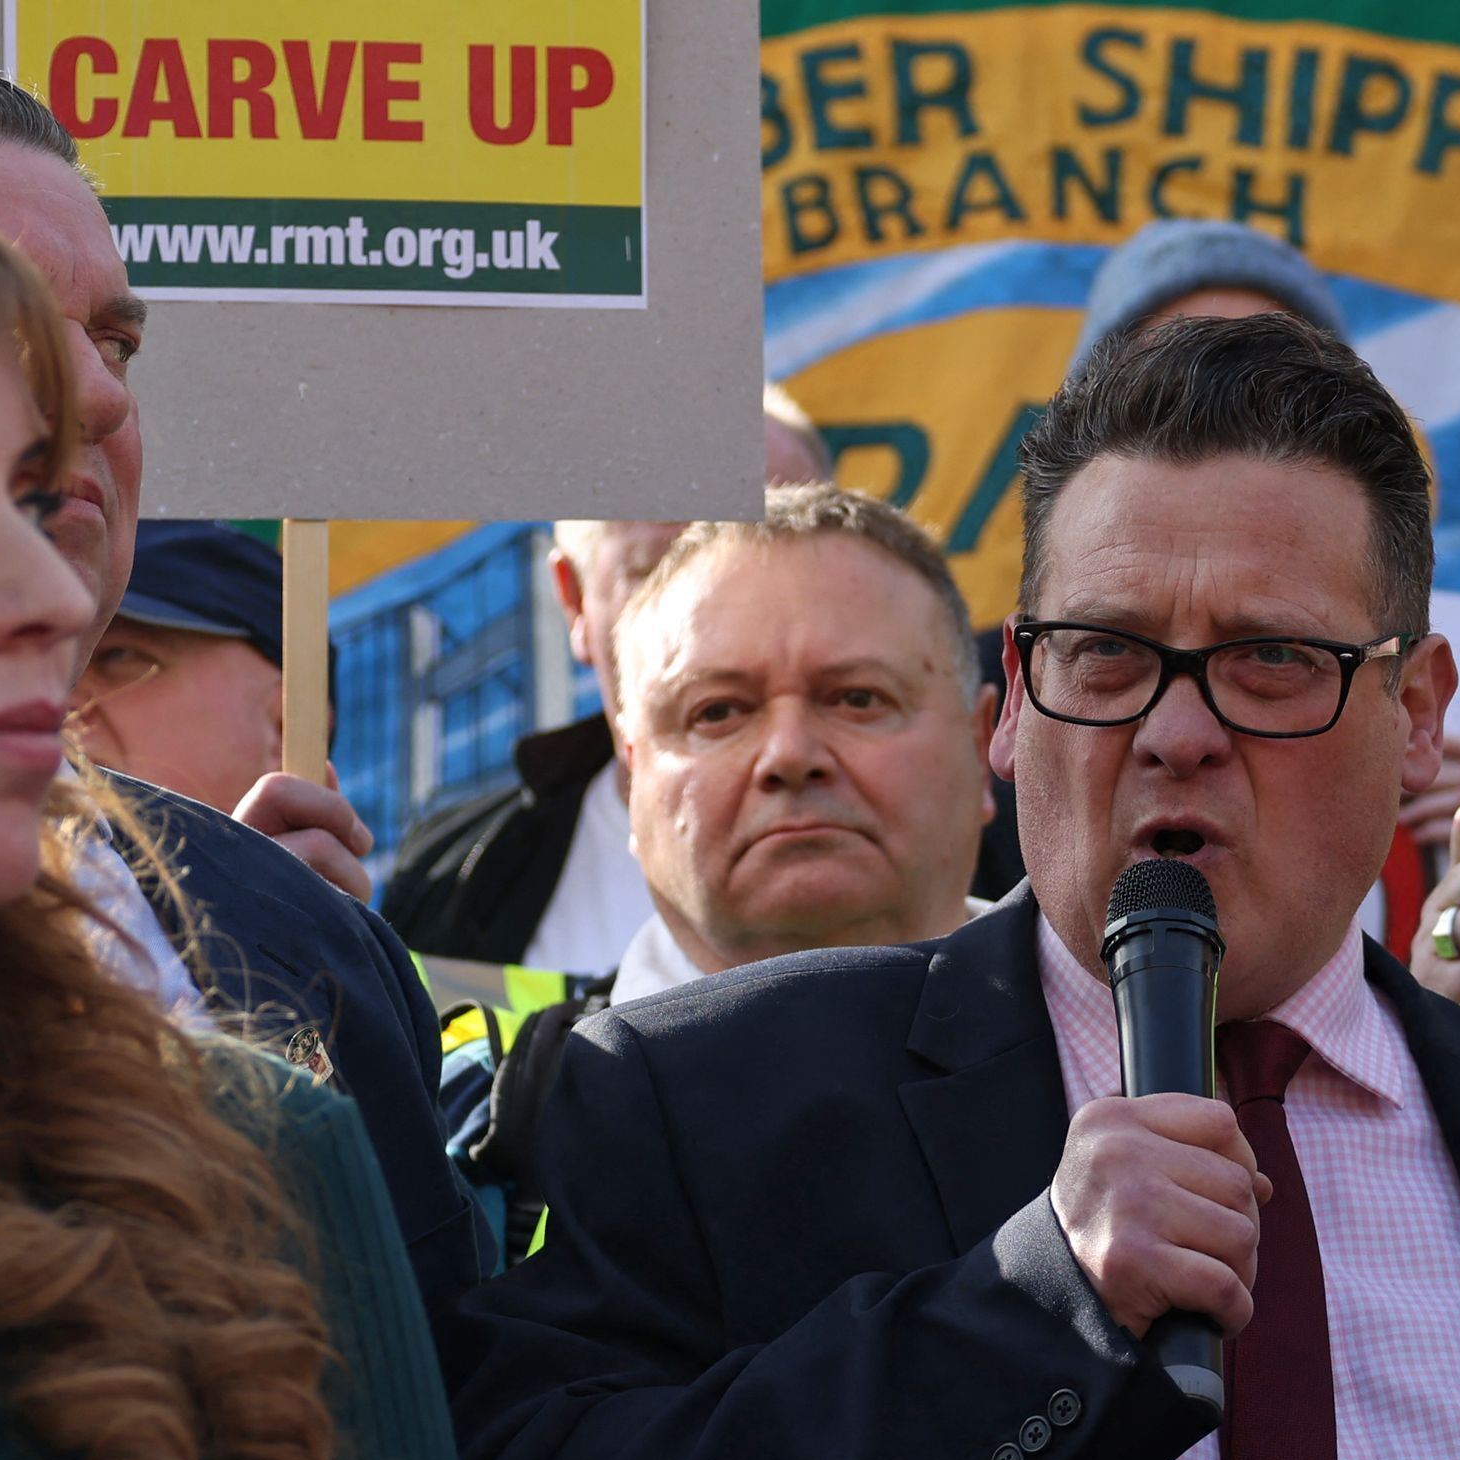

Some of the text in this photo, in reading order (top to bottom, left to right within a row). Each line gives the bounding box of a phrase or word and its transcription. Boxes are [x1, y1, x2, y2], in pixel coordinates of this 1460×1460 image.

[48, 35, 616, 147] CARVE UP
[109, 215, 561, 279] www.rmt.org.uk
[780, 146, 1309, 254] BRANCH
